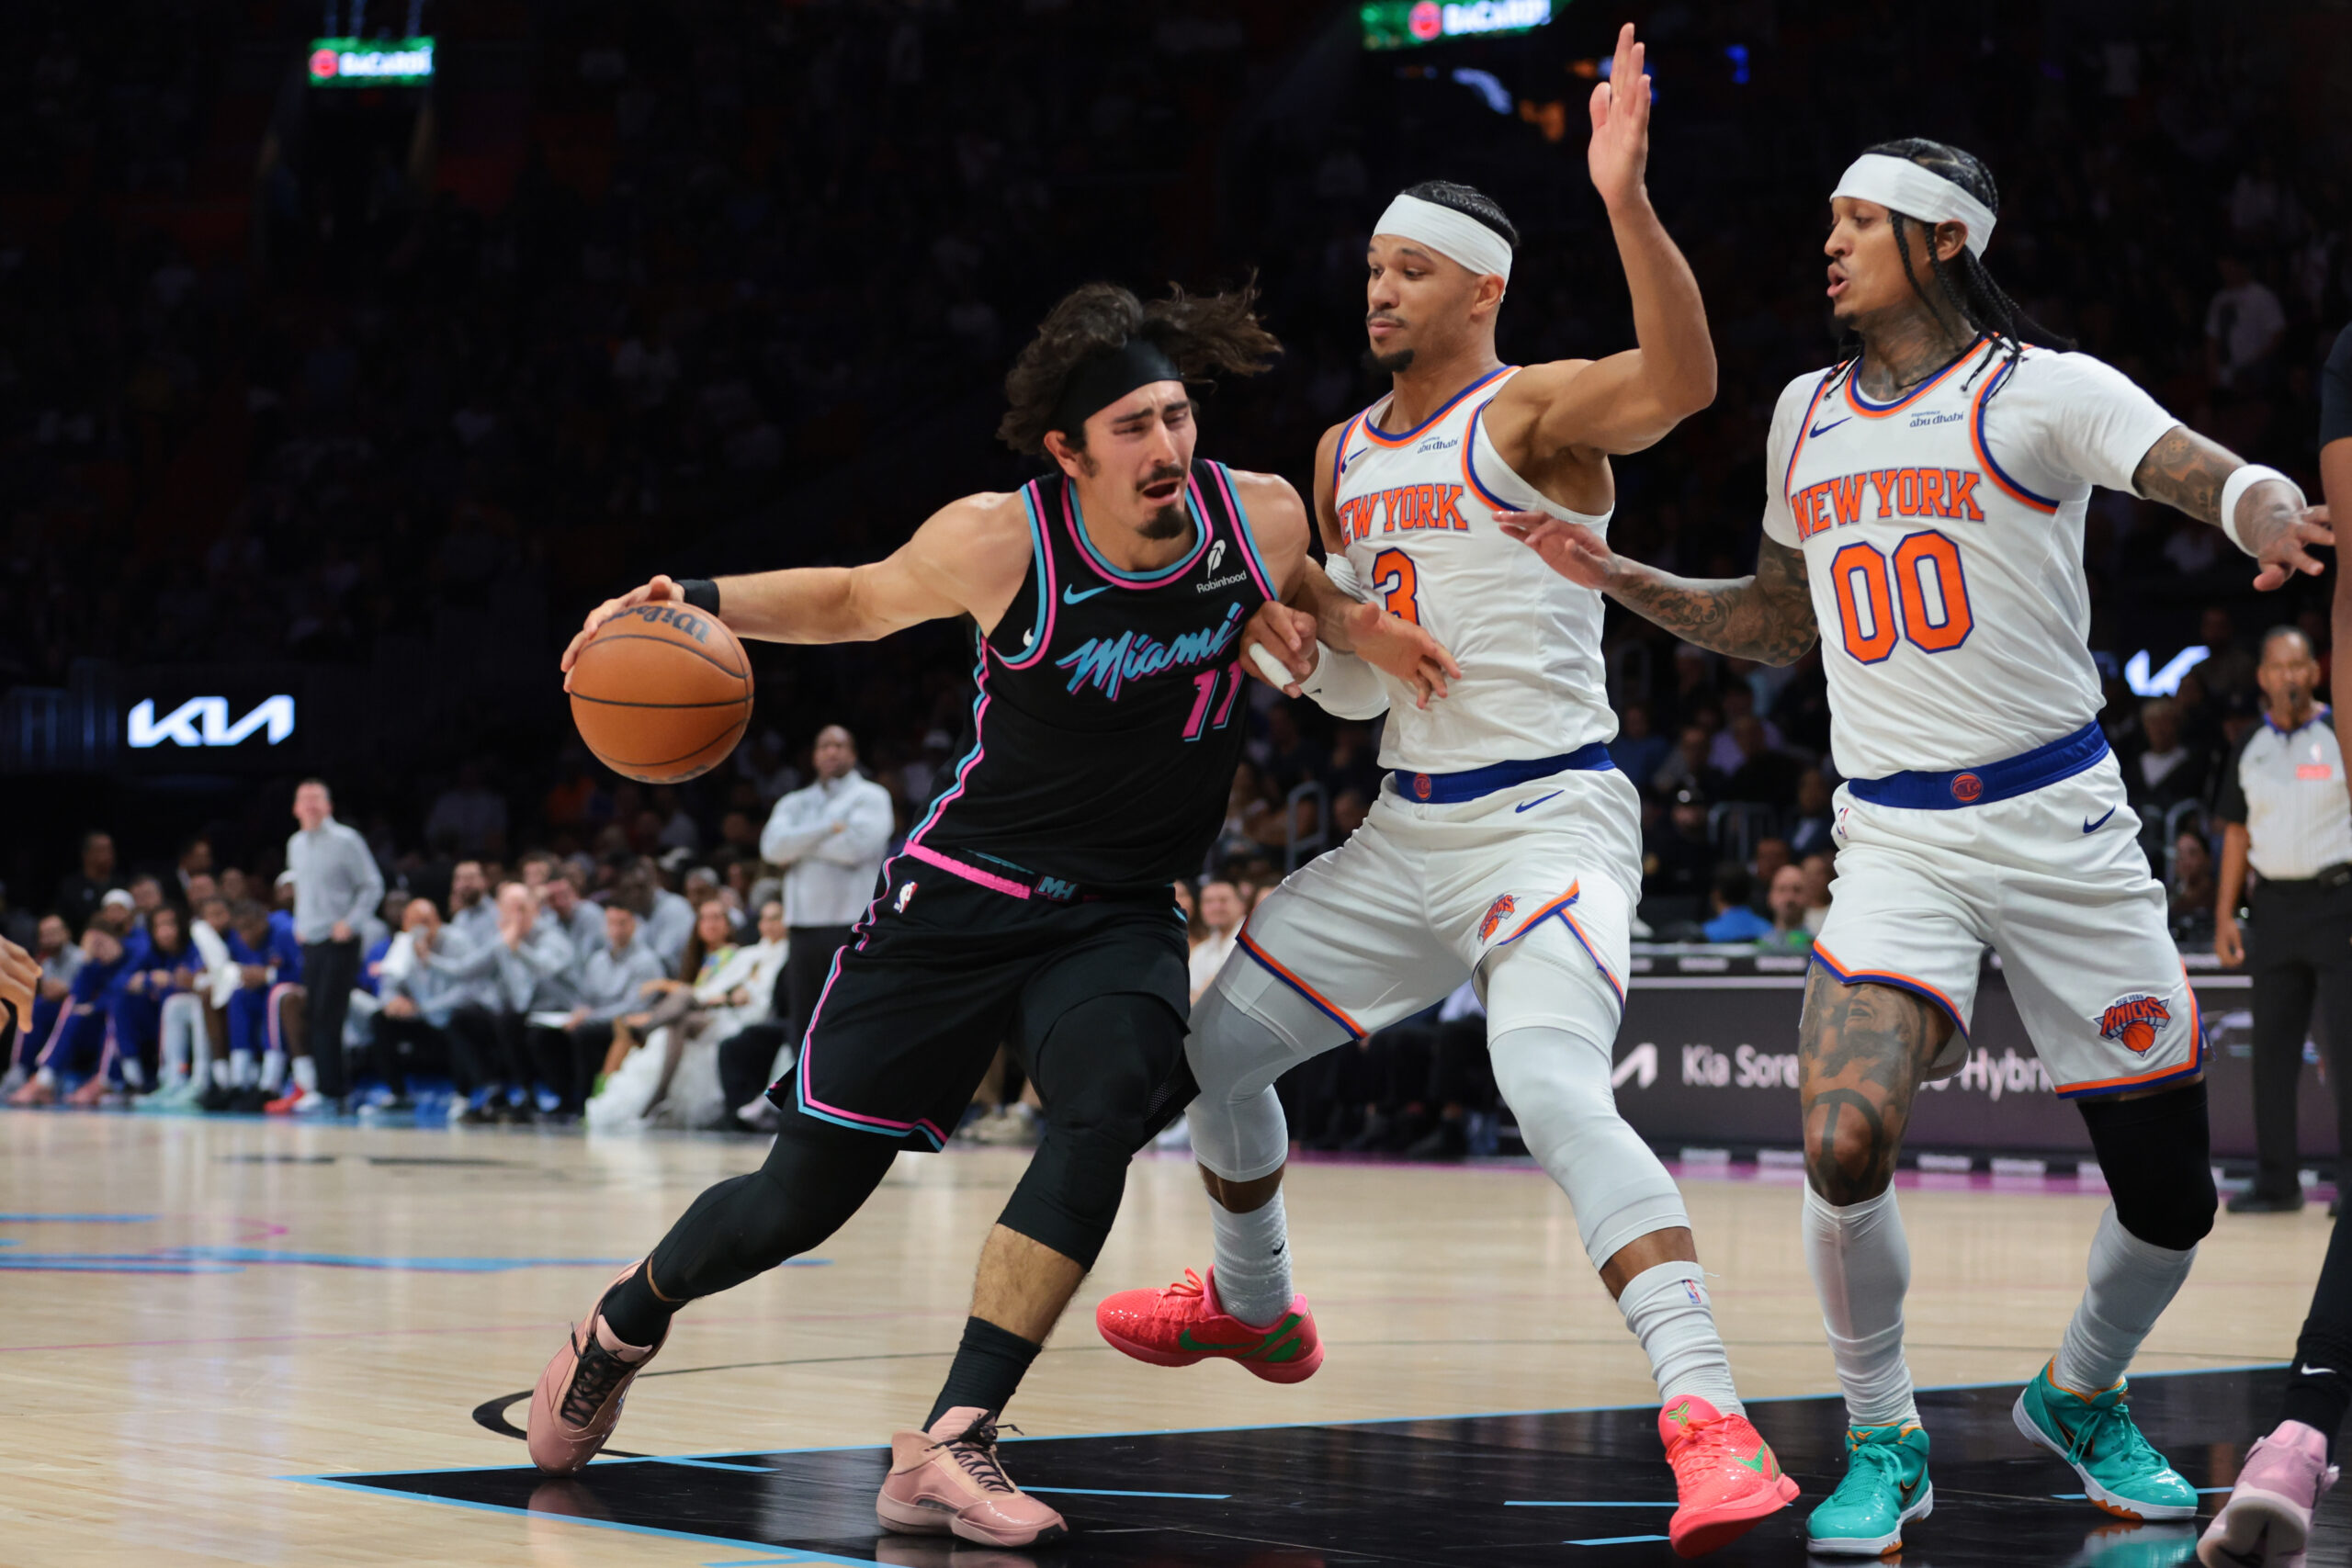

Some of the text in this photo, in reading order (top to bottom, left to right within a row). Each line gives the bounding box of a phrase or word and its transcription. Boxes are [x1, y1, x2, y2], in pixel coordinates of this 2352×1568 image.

[1909, 411, 1964, 428] abu dhabi
[1339, 483, 1469, 549] EW YORK
[1791, 467, 1985, 543] NEW YORK
[1196, 570, 1247, 594] Robinhood
[1372, 547, 1420, 626] 3
[1830, 528, 1974, 666] 00
[1055, 602, 1244, 701] Miami
[1182, 660, 1246, 742] 11
[2099, 996, 2171, 1039] KNICKS
[1682, 1044, 1730, 1087] Kia
[1735, 1043, 1799, 1089] Sore
